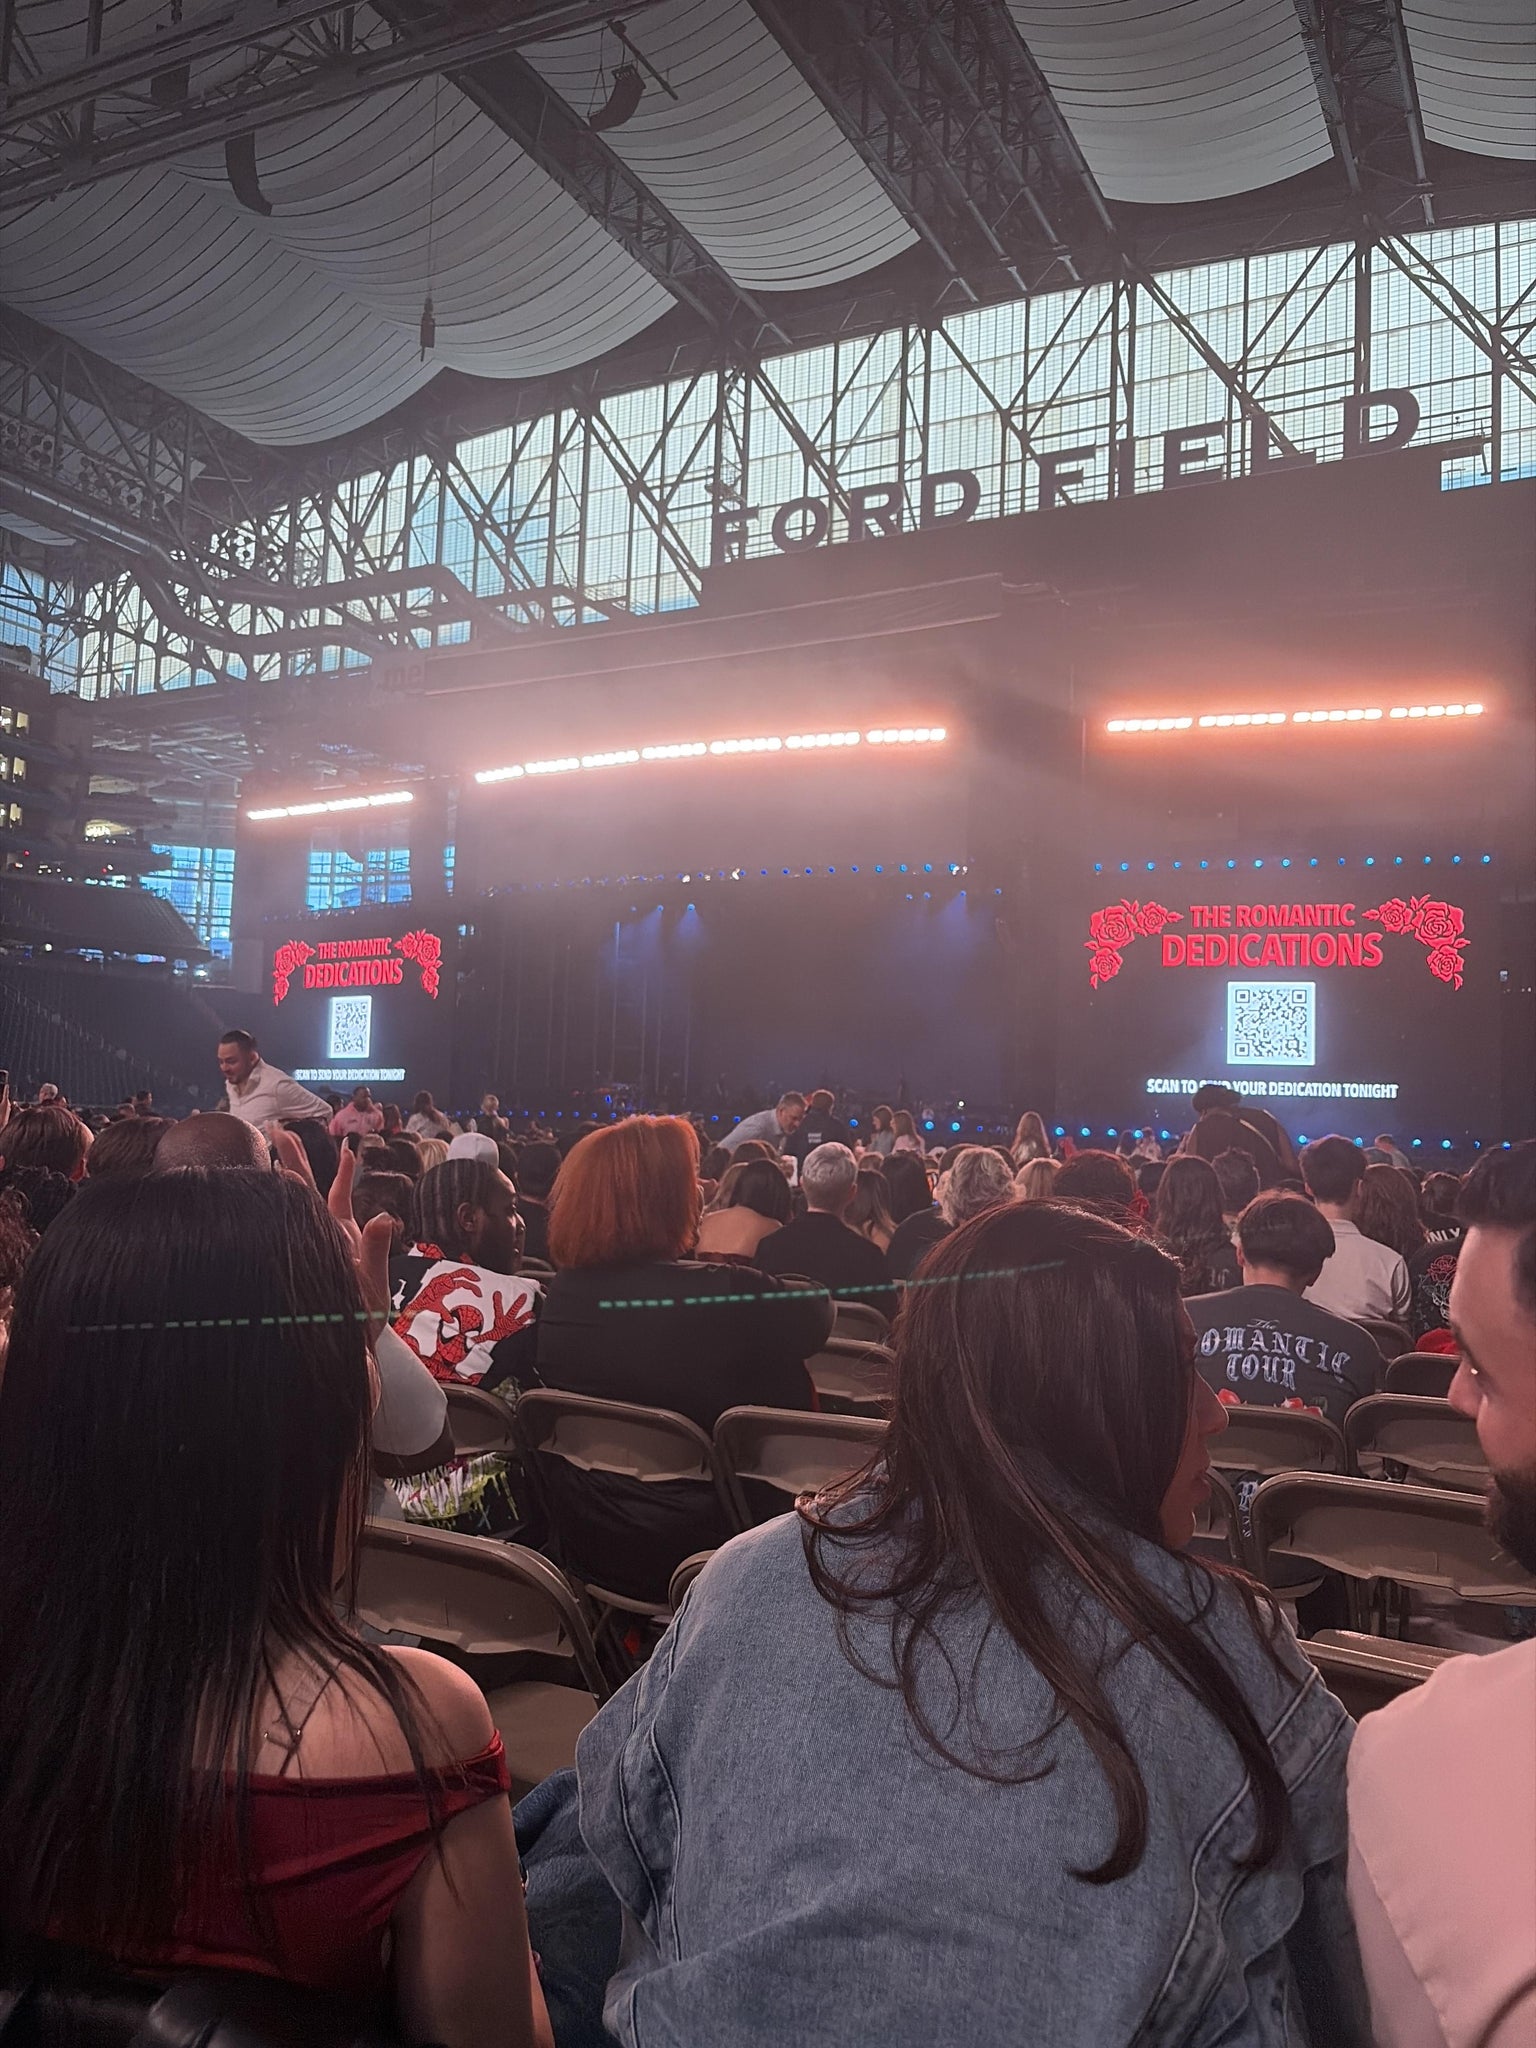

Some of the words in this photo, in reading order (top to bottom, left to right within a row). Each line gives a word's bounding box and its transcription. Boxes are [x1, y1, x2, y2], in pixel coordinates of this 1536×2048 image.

[711, 468, 980, 567] FORD
[1039, 387, 1421, 510] FIELD
[1190, 904, 1231, 928] THE
[1236, 903, 1355, 928] ROMANTIC
[317, 940, 337, 959] THE
[337, 937, 392, 958] ROMANTIC
[1161, 932, 1383, 968] DEDICATIONS
[304, 958, 403, 988] DEDICATIONS
[1146, 1078, 1179, 1094] SCAN
[1180, 1079, 1198, 1094] TO
[1233, 1080, 1268, 1096] YOUR
[1268, 1081, 1341, 1097] DEDICATION
[1342, 1083, 1399, 1099] TONIGHT
[1246, 1318, 1279, 1330] The
[1200, 1326, 1351, 1383] OMANTIC
[1226, 1353, 1296, 1391] TOUR
